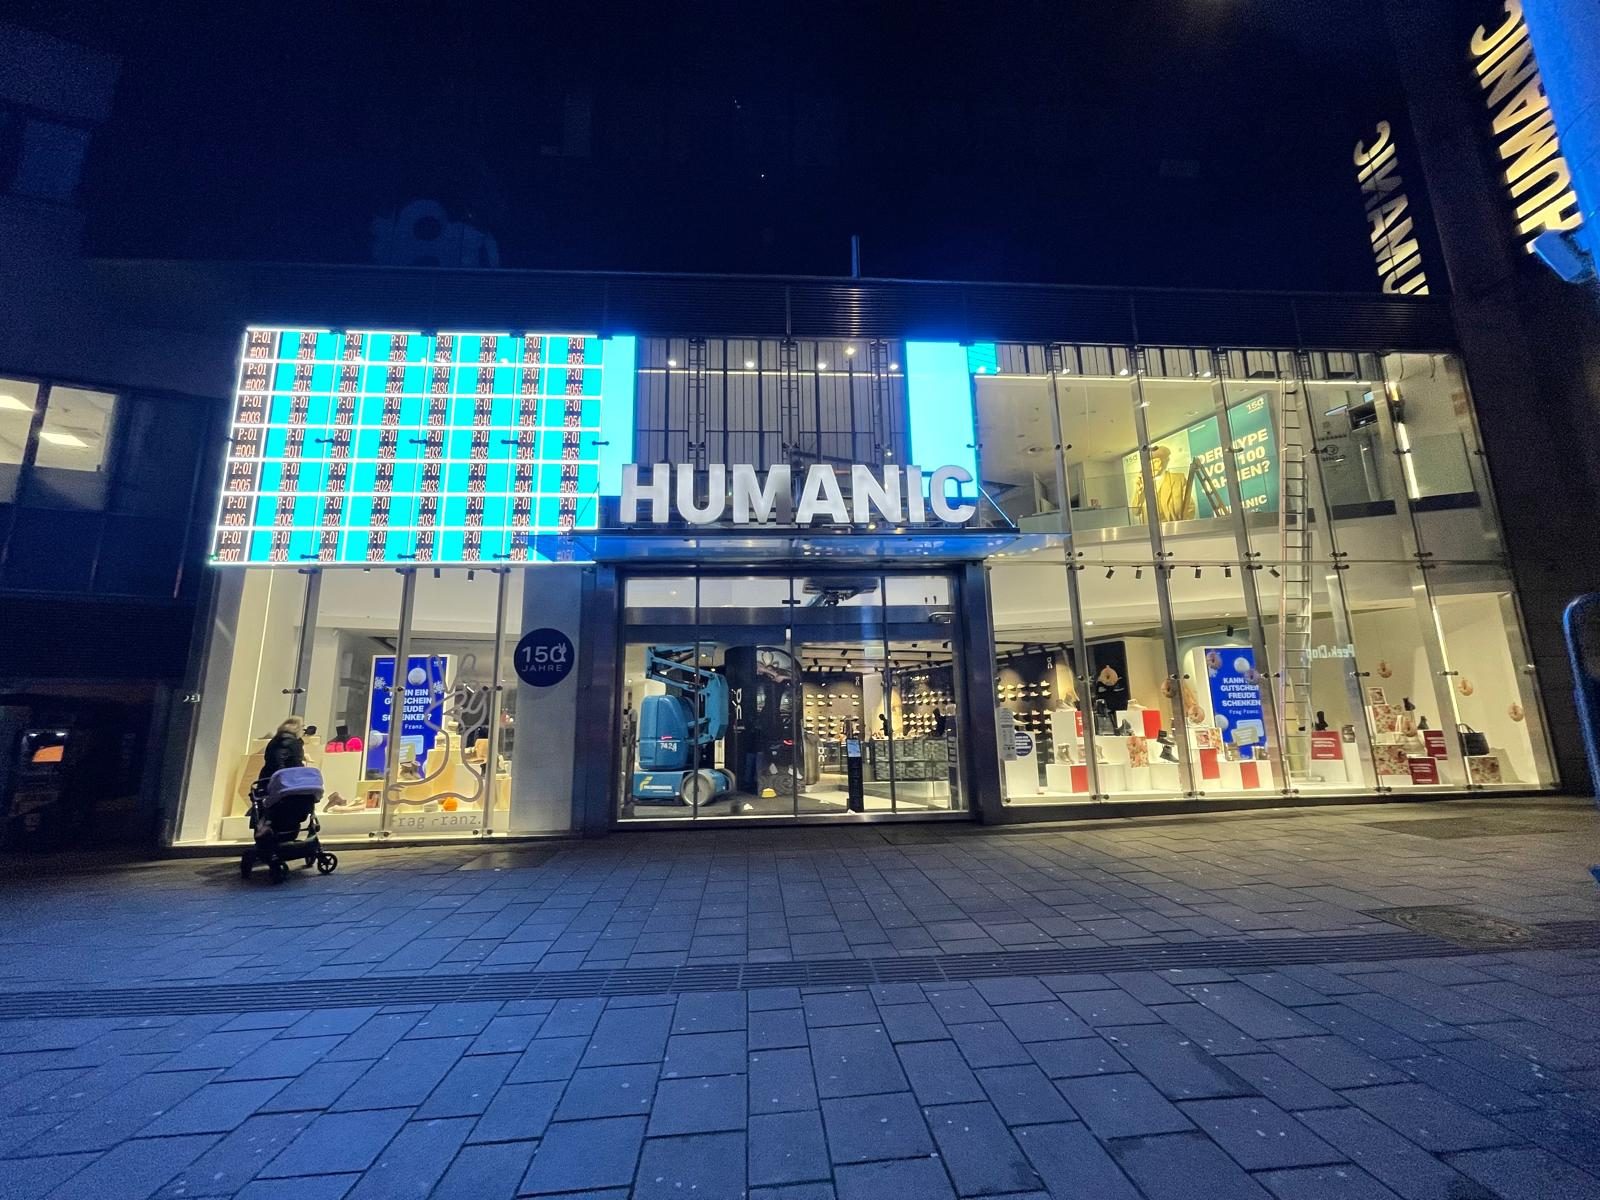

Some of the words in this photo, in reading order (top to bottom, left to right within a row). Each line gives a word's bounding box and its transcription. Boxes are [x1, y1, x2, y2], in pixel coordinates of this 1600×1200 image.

[1470, 0, 1583, 254] HUMANIC
[252, 332, 271, 343] P:01
[300, 333, 317, 344] P:01
[345, 334, 362, 345] P:01
[390, 335, 407, 346] P:01
[436, 336, 452, 347] P:01
[480, 336, 496, 347] P:01
[525, 337, 541, 348] P:01
[568, 338, 584, 349] P:01
[249, 348, 268, 359] #001
[248, 364, 267, 375] P:01
[295, 365, 313, 376] P:01
[341, 366, 358, 377] P:01
[387, 366, 404, 377] P:01
[433, 367, 449, 378] P:01
[478, 368, 494, 379] P:01
[523, 368, 539, 379] P:01
[566, 369, 583, 380] P:01
[245, 379, 264, 391] #002
[243, 396, 262, 407] P:01
[291, 397, 308, 408] P:01
[337, 397, 354, 408] P:01
[384, 398, 401, 409] P:01
[429, 398, 446, 410] P:01
[475, 399, 491, 410] P:01
[520, 399, 537, 411] P:01
[565, 400, 581, 412] P:01
[240, 412, 260, 423] #003
[238, 429, 257, 440] P:01
[286, 429, 304, 440] P:01
[333, 430, 350, 441] P:01
[380, 430, 397, 442] P:01
[426, 430, 443, 442] P:01
[472, 431, 488, 443] P:01
[518, 431, 534, 443] P:01
[563, 432, 579, 444] P:01
[235, 445, 255, 457] #004
[1205, 461, 1225, 477] VO
[1239, 446, 1265, 465] 100
[233, 462, 252, 474] P:01
[281, 462, 299, 475] P:01
[329, 463, 347, 475] P:01
[376, 463, 393, 475] P:01
[423, 463, 440, 476] P:01
[469, 464, 486, 476] P:01
[516, 464, 532, 476] P:01
[561, 464, 578, 476] P:01
[230, 479, 251, 491] #005
[620, 464, 976, 525] HUMANIC
[227, 496, 247, 508] P:01
[277, 497, 295, 509] P:01
[325, 497, 343, 509] P:01
[372, 497, 390, 509] P:01
[419, 497, 437, 509] P:01
[466, 498, 483, 510] P:01
[514, 498, 530, 510] P:01
[560, 498, 576, 510] P:01
[225, 514, 245, 525] #006
[221, 531, 241, 544] P:01
[272, 531, 290, 544] P:01
[320, 531, 338, 544] P:01
[368, 531, 386, 544] P:01
[416, 532, 434, 545] P:01
[463, 532, 480, 545] P:01
[220, 549, 240, 561] #007
[522, 644, 567, 663] 150
[521, 664, 562, 672] JAHRE
